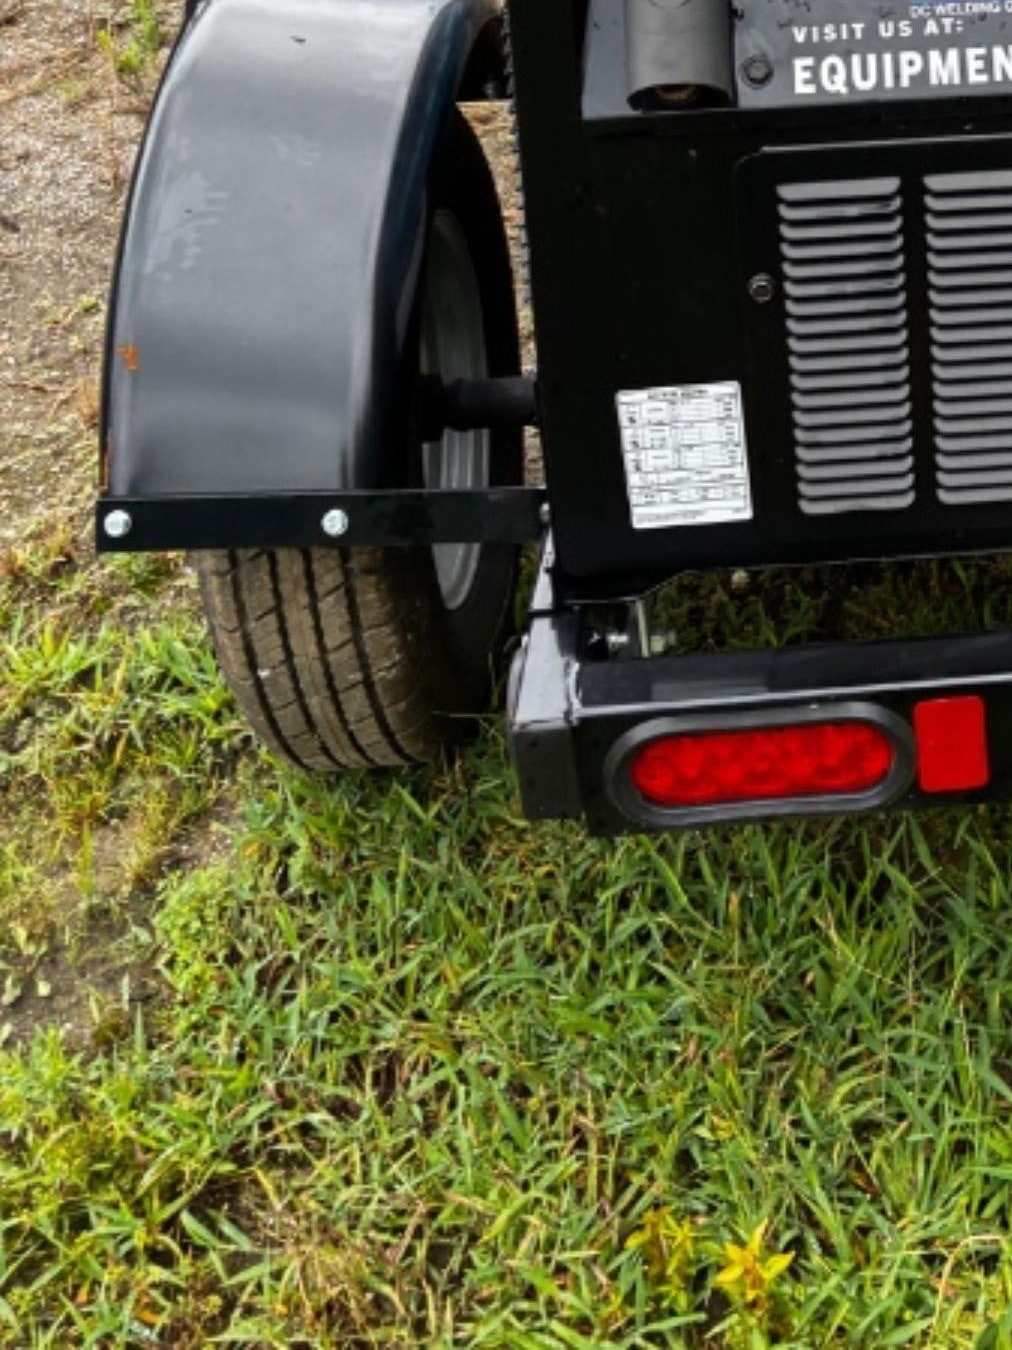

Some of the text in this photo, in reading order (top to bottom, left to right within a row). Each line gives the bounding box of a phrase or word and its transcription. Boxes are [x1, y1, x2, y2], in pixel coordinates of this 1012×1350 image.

[935, 0, 1001, 17] WELDING
[791, 16, 965, 44] VISIT US AT:
